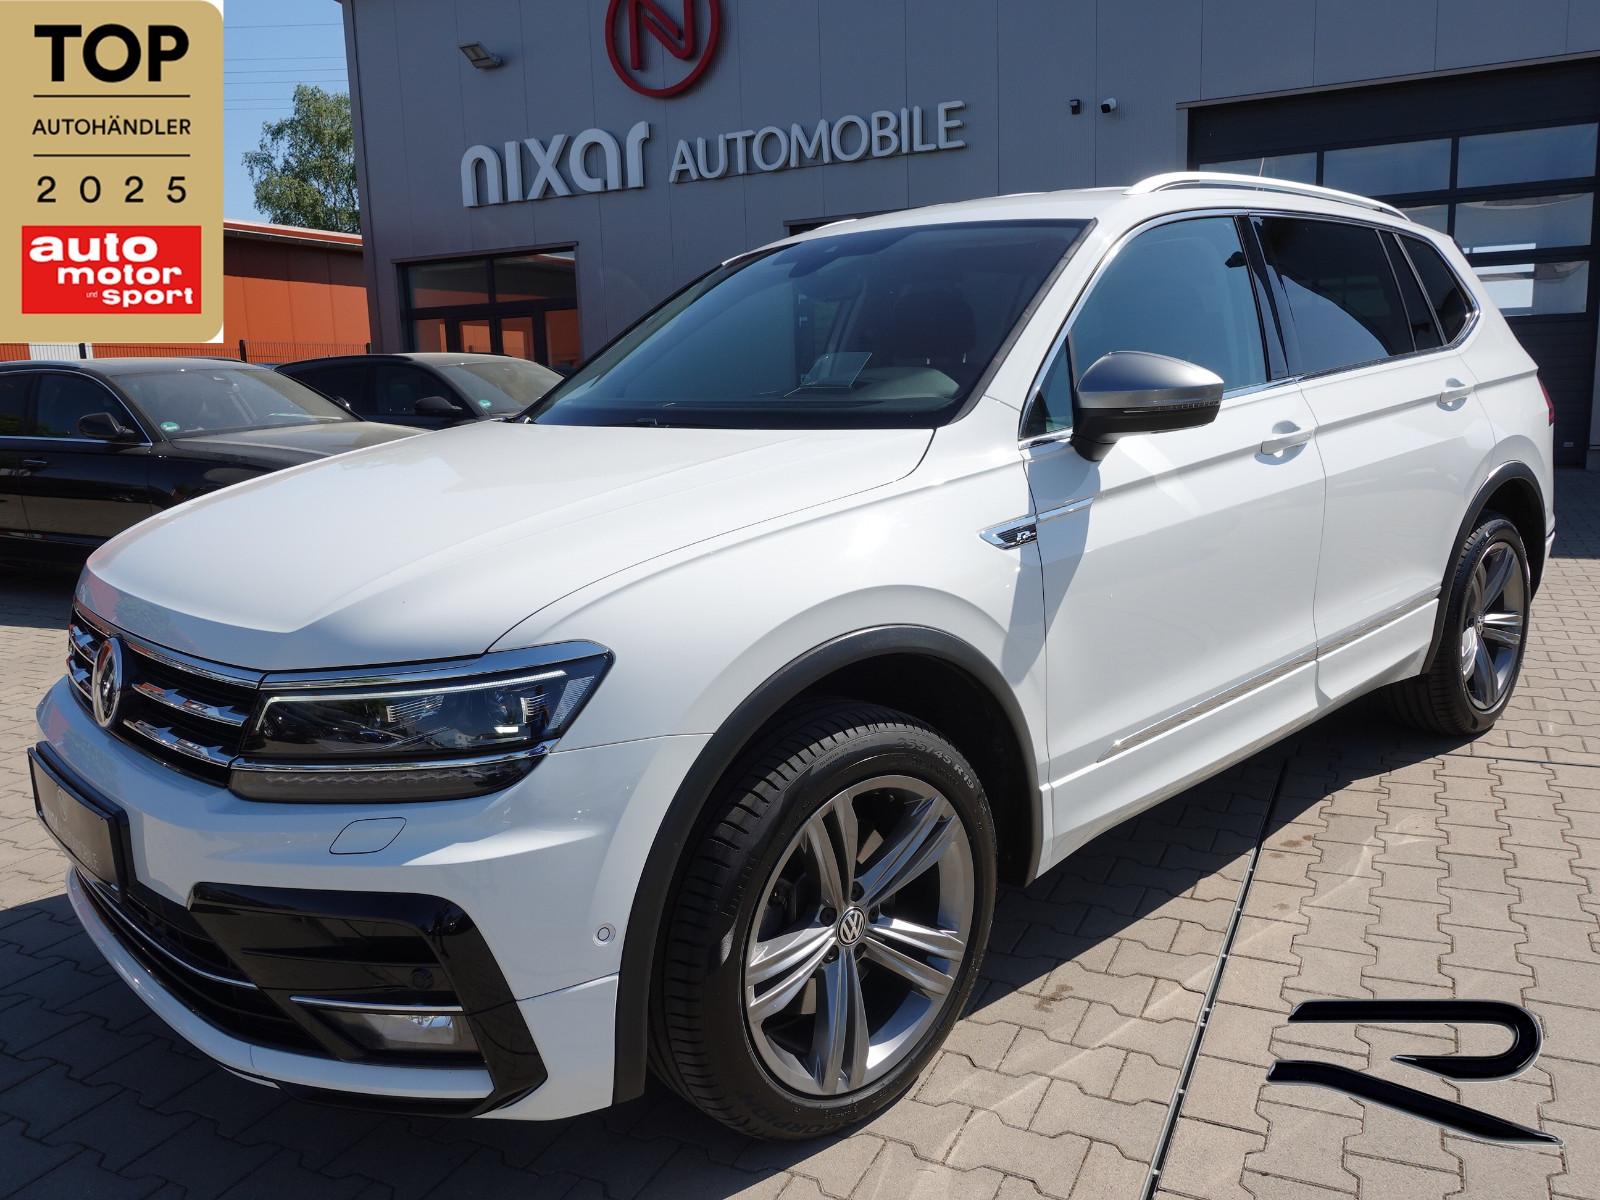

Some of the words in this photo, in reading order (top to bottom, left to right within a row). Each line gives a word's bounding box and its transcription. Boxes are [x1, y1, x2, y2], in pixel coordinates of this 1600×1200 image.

[460, 121, 650, 207] nixar
[668, 100, 966, 183] AUTOMOBILE
[896, 737, 953, 764] 255/45
[953, 763, 975, 789] R19
[839, 909, 864, 943] VW
